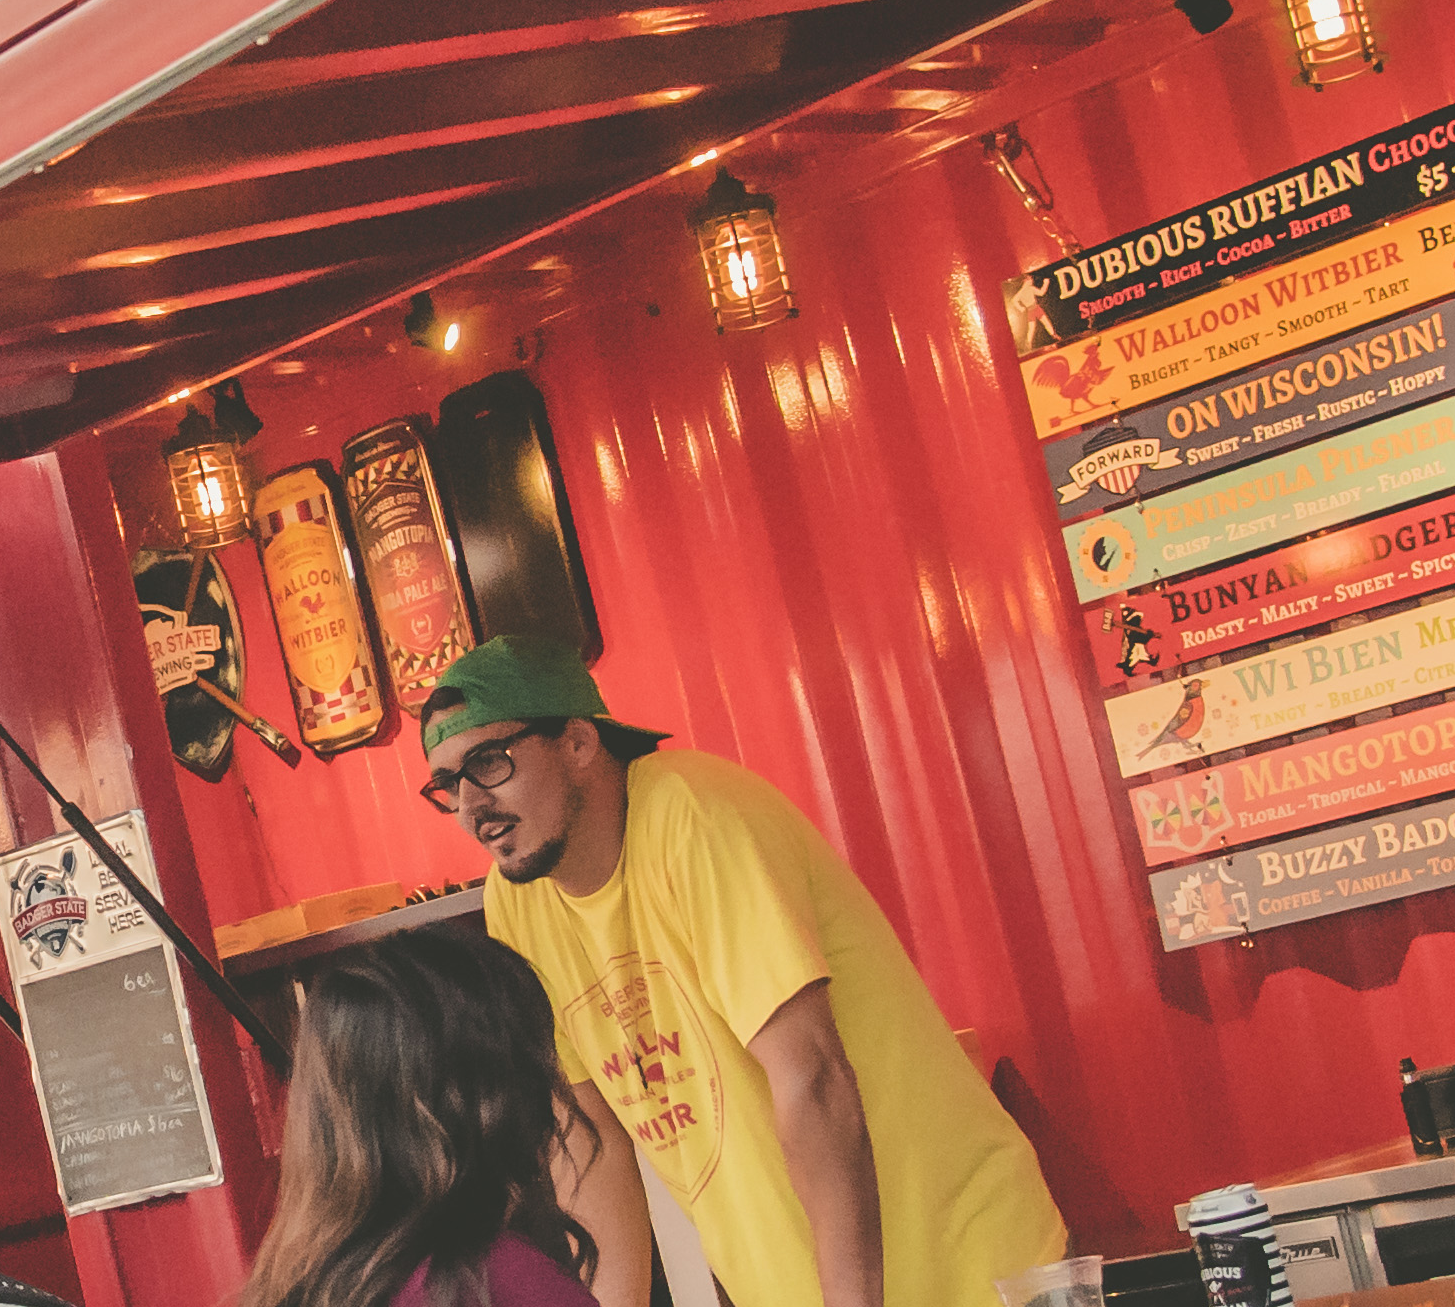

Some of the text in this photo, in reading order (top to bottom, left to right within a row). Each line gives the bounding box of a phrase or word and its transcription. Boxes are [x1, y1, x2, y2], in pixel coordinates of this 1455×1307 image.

[1055, 217, 1206, 299] DUBIOUS
[1208, 152, 1365, 240] RUFFIAN
[1079, 283, 1146, 319] SMOOTH
[1160, 262, 1202, 288] RICH
[1216, 234, 1275, 266] COCOA
[1289, 204, 1352, 239] BITTER
[1417, 162, 1448, 197] $5
[1114, 294, 1261, 362] WALLOON
[1265, 242, 1403, 308] WITBIER
[1129, 358, 1189, 391] BRIGHT
[1204, 332, 1261, 363] TANGY
[1277, 301, 1348, 338] SMOOTH
[1364, 278, 1410, 305] TART
[1167, 400, 1221, 439] ON
[1222, 313, 1447, 420] WISCONSIN!
[1185, 438, 1240, 466] SWEET
[1251, 414, 1305, 444] FRESH
[1317, 388, 1376, 421] RUSTIC
[1388, 366, 1446, 396] HOPPY
[1076, 443, 1154, 481] FORWARD
[1143, 467, 1316, 539] PENINSULA
[1162, 533, 1212, 561] CRISP
[1225, 512, 1277, 542] ZESTY
[1293, 486, 1362, 520] BREADY
[1378, 461, 1446, 493] FLORAL
[1161, 557, 1308, 622] BUNYAN
[1181, 619, 1245, 649] ROASTY
[1260, 596, 1319, 625] MALTY
[1334, 572, 1395, 604] SWEET
[166, 629, 213, 653] STATE
[1233, 659, 1294, 703] WI
[1302, 630, 1404, 685] BIEN
[1250, 703, 1307, 731] TANGY
[1326, 679, 1396, 710] BREADY
[1237, 804, 1296, 830] FLORAL
[1307, 781, 1386, 812] TROPICAL
[1257, 834, 1367, 887] BUZZY
[1258, 889, 1322, 915] COFFEE
[1336, 867, 1414, 899] VANILLA
[15, 900, 85, 933] BADGER STATE
[108, 910, 145, 934] HERE
